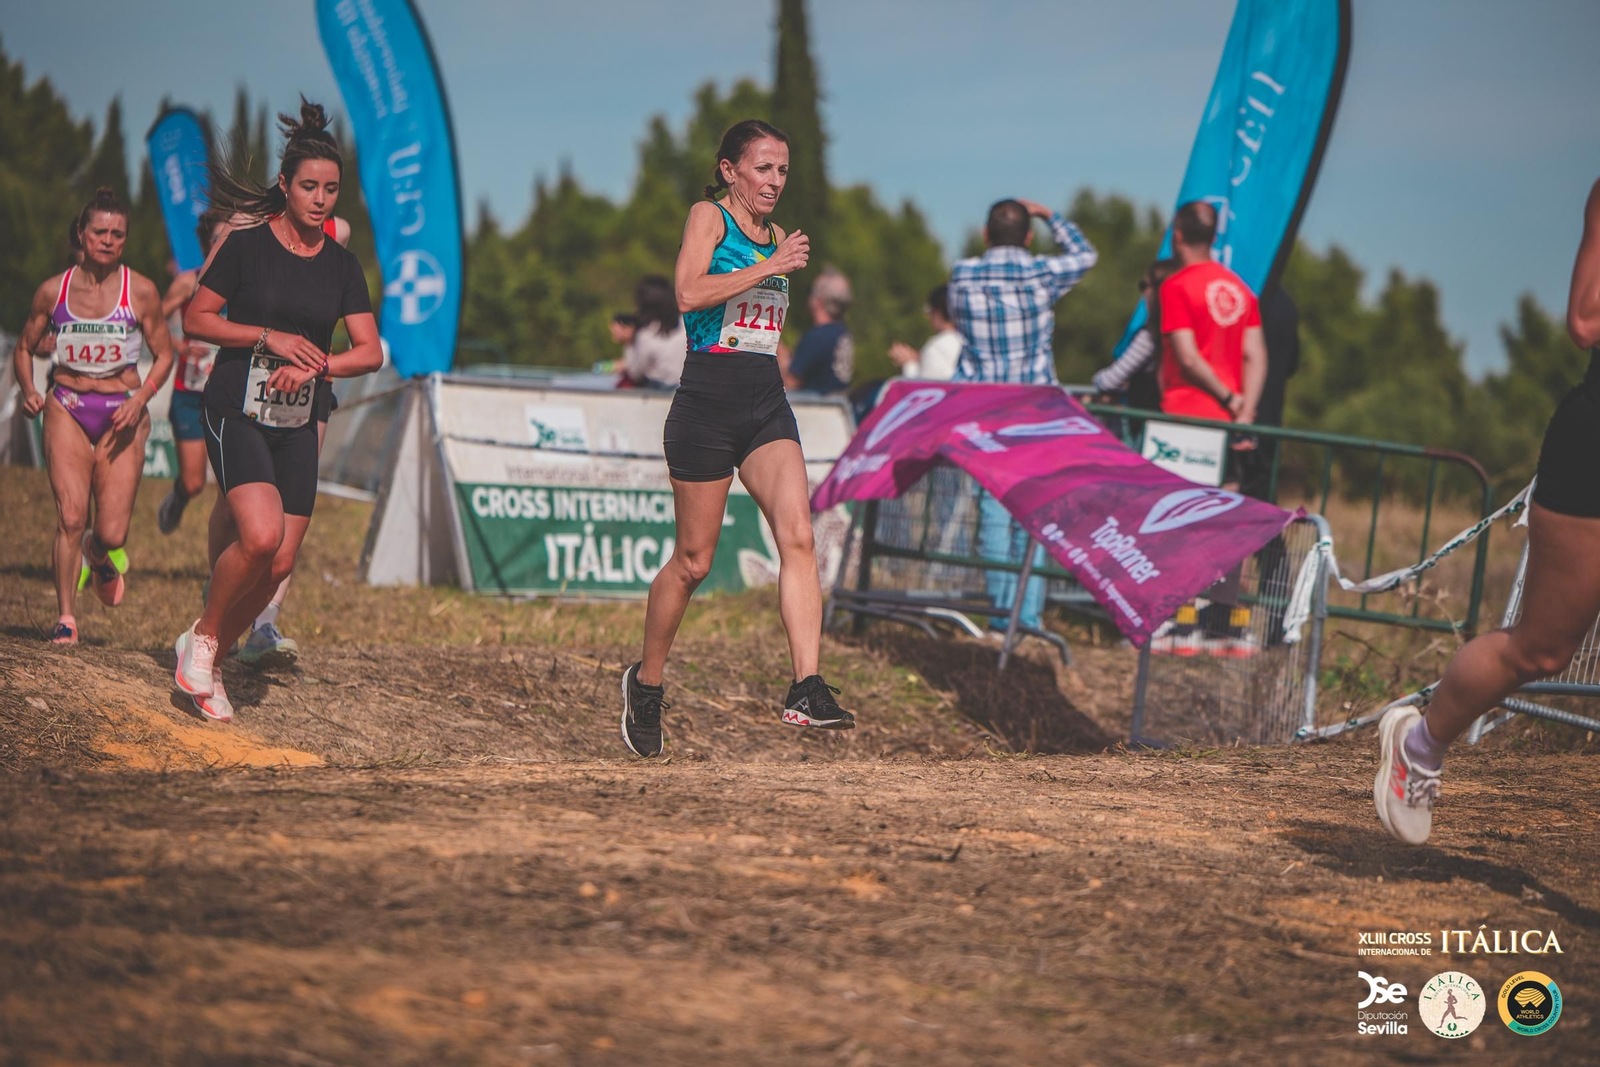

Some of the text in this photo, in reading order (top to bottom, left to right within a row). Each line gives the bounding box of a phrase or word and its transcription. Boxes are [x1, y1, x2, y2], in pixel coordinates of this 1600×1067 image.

[734, 301, 784, 333] 1218
[65, 344, 122, 363] 1423
[254, 380, 311, 407] 1103
[472, 486, 736, 526] CROSS INTERNACIL
[1089, 515, 1161, 585] TopRunner
